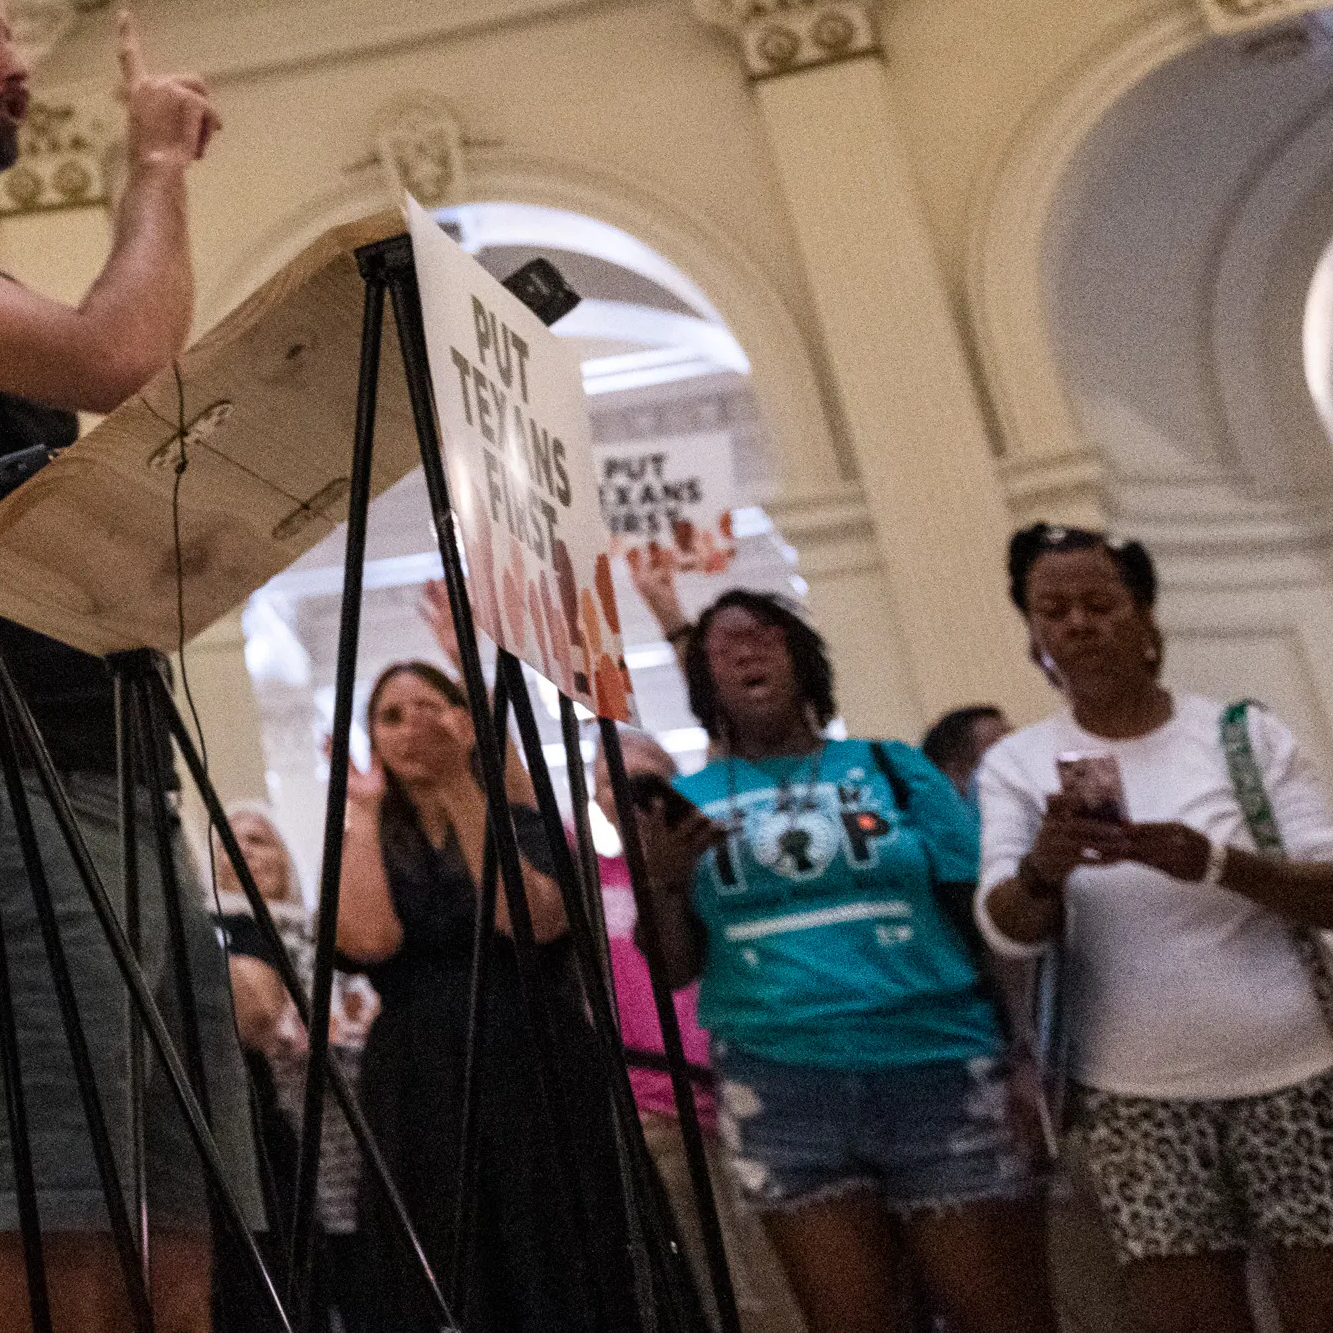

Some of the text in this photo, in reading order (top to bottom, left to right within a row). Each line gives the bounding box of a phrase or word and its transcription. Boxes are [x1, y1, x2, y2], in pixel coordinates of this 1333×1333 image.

[471, 294, 529, 404] PUT
[450, 345, 571, 507] TEXANS
[597, 477, 702, 508] EXANS
[604, 452, 666, 480] PUT
[484, 445, 559, 563] FIRST
[608, 508, 679, 534] IRST
